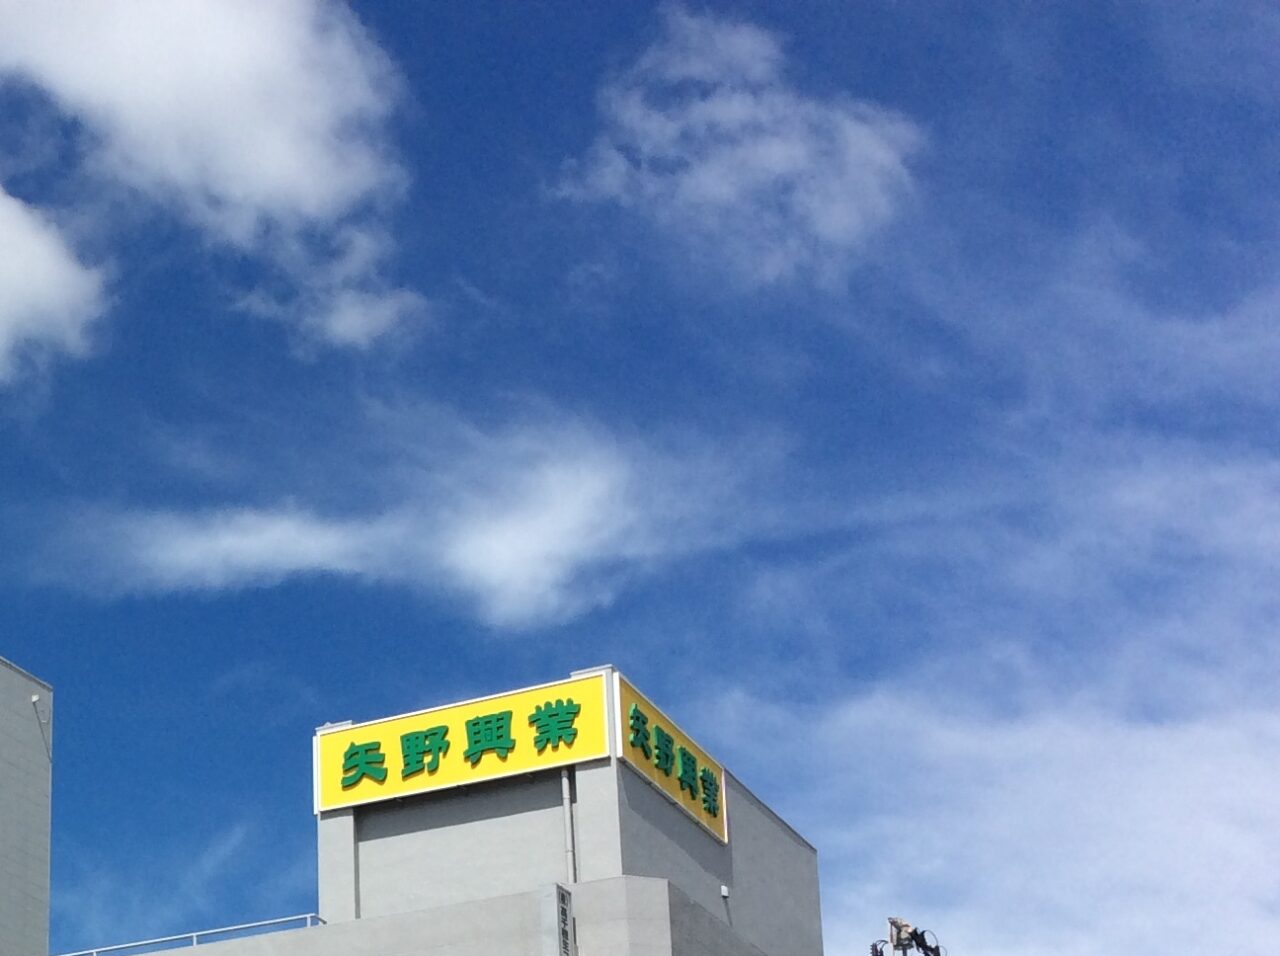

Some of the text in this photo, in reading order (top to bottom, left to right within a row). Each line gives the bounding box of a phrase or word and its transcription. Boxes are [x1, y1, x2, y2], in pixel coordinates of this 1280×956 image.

[341, 698, 581, 789] 矢野興業
[629, 703, 720, 818] 矢野興業
